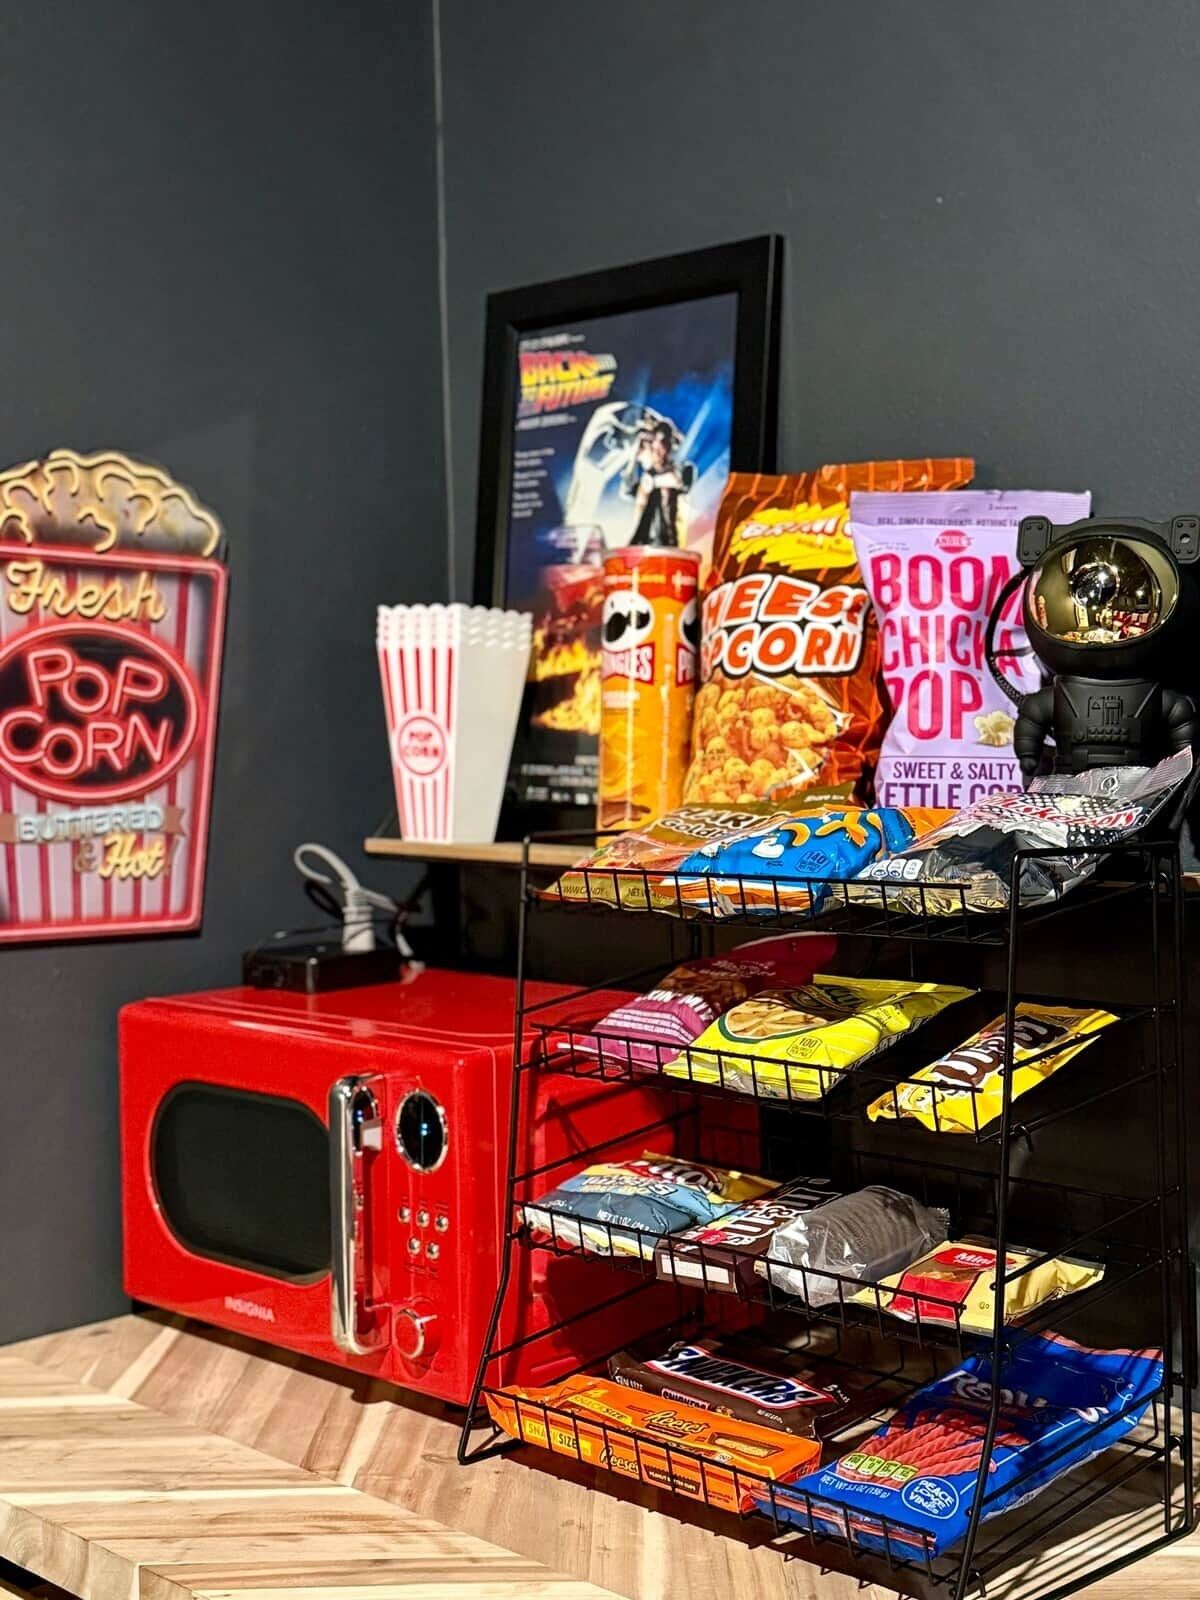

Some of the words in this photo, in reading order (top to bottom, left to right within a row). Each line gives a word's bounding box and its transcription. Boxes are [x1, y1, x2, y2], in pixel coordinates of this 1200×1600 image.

[6, 560, 166, 622] Fresh
[27, 647, 166, 716] POP
[0, 708, 171, 776] CORN
[409, 730, 433, 742] POP
[893, 761, 946, 780] SWEET
[951, 761, 965, 780] &
[968, 762, 1016, 782] SALTY
[884, 782, 962, 809] ETTLE
[18, 803, 165, 843] BUTTERED
[800, 1037, 819, 1049] 100
[224, 1295, 276, 1323] INSIGNIA
[655, 1345, 820, 1404] SNICKERS
[603, 1407, 628, 1420] SIZE
[558, 1431, 579, 1449] SIZE
[919, 1479, 955, 1507] PEACE
